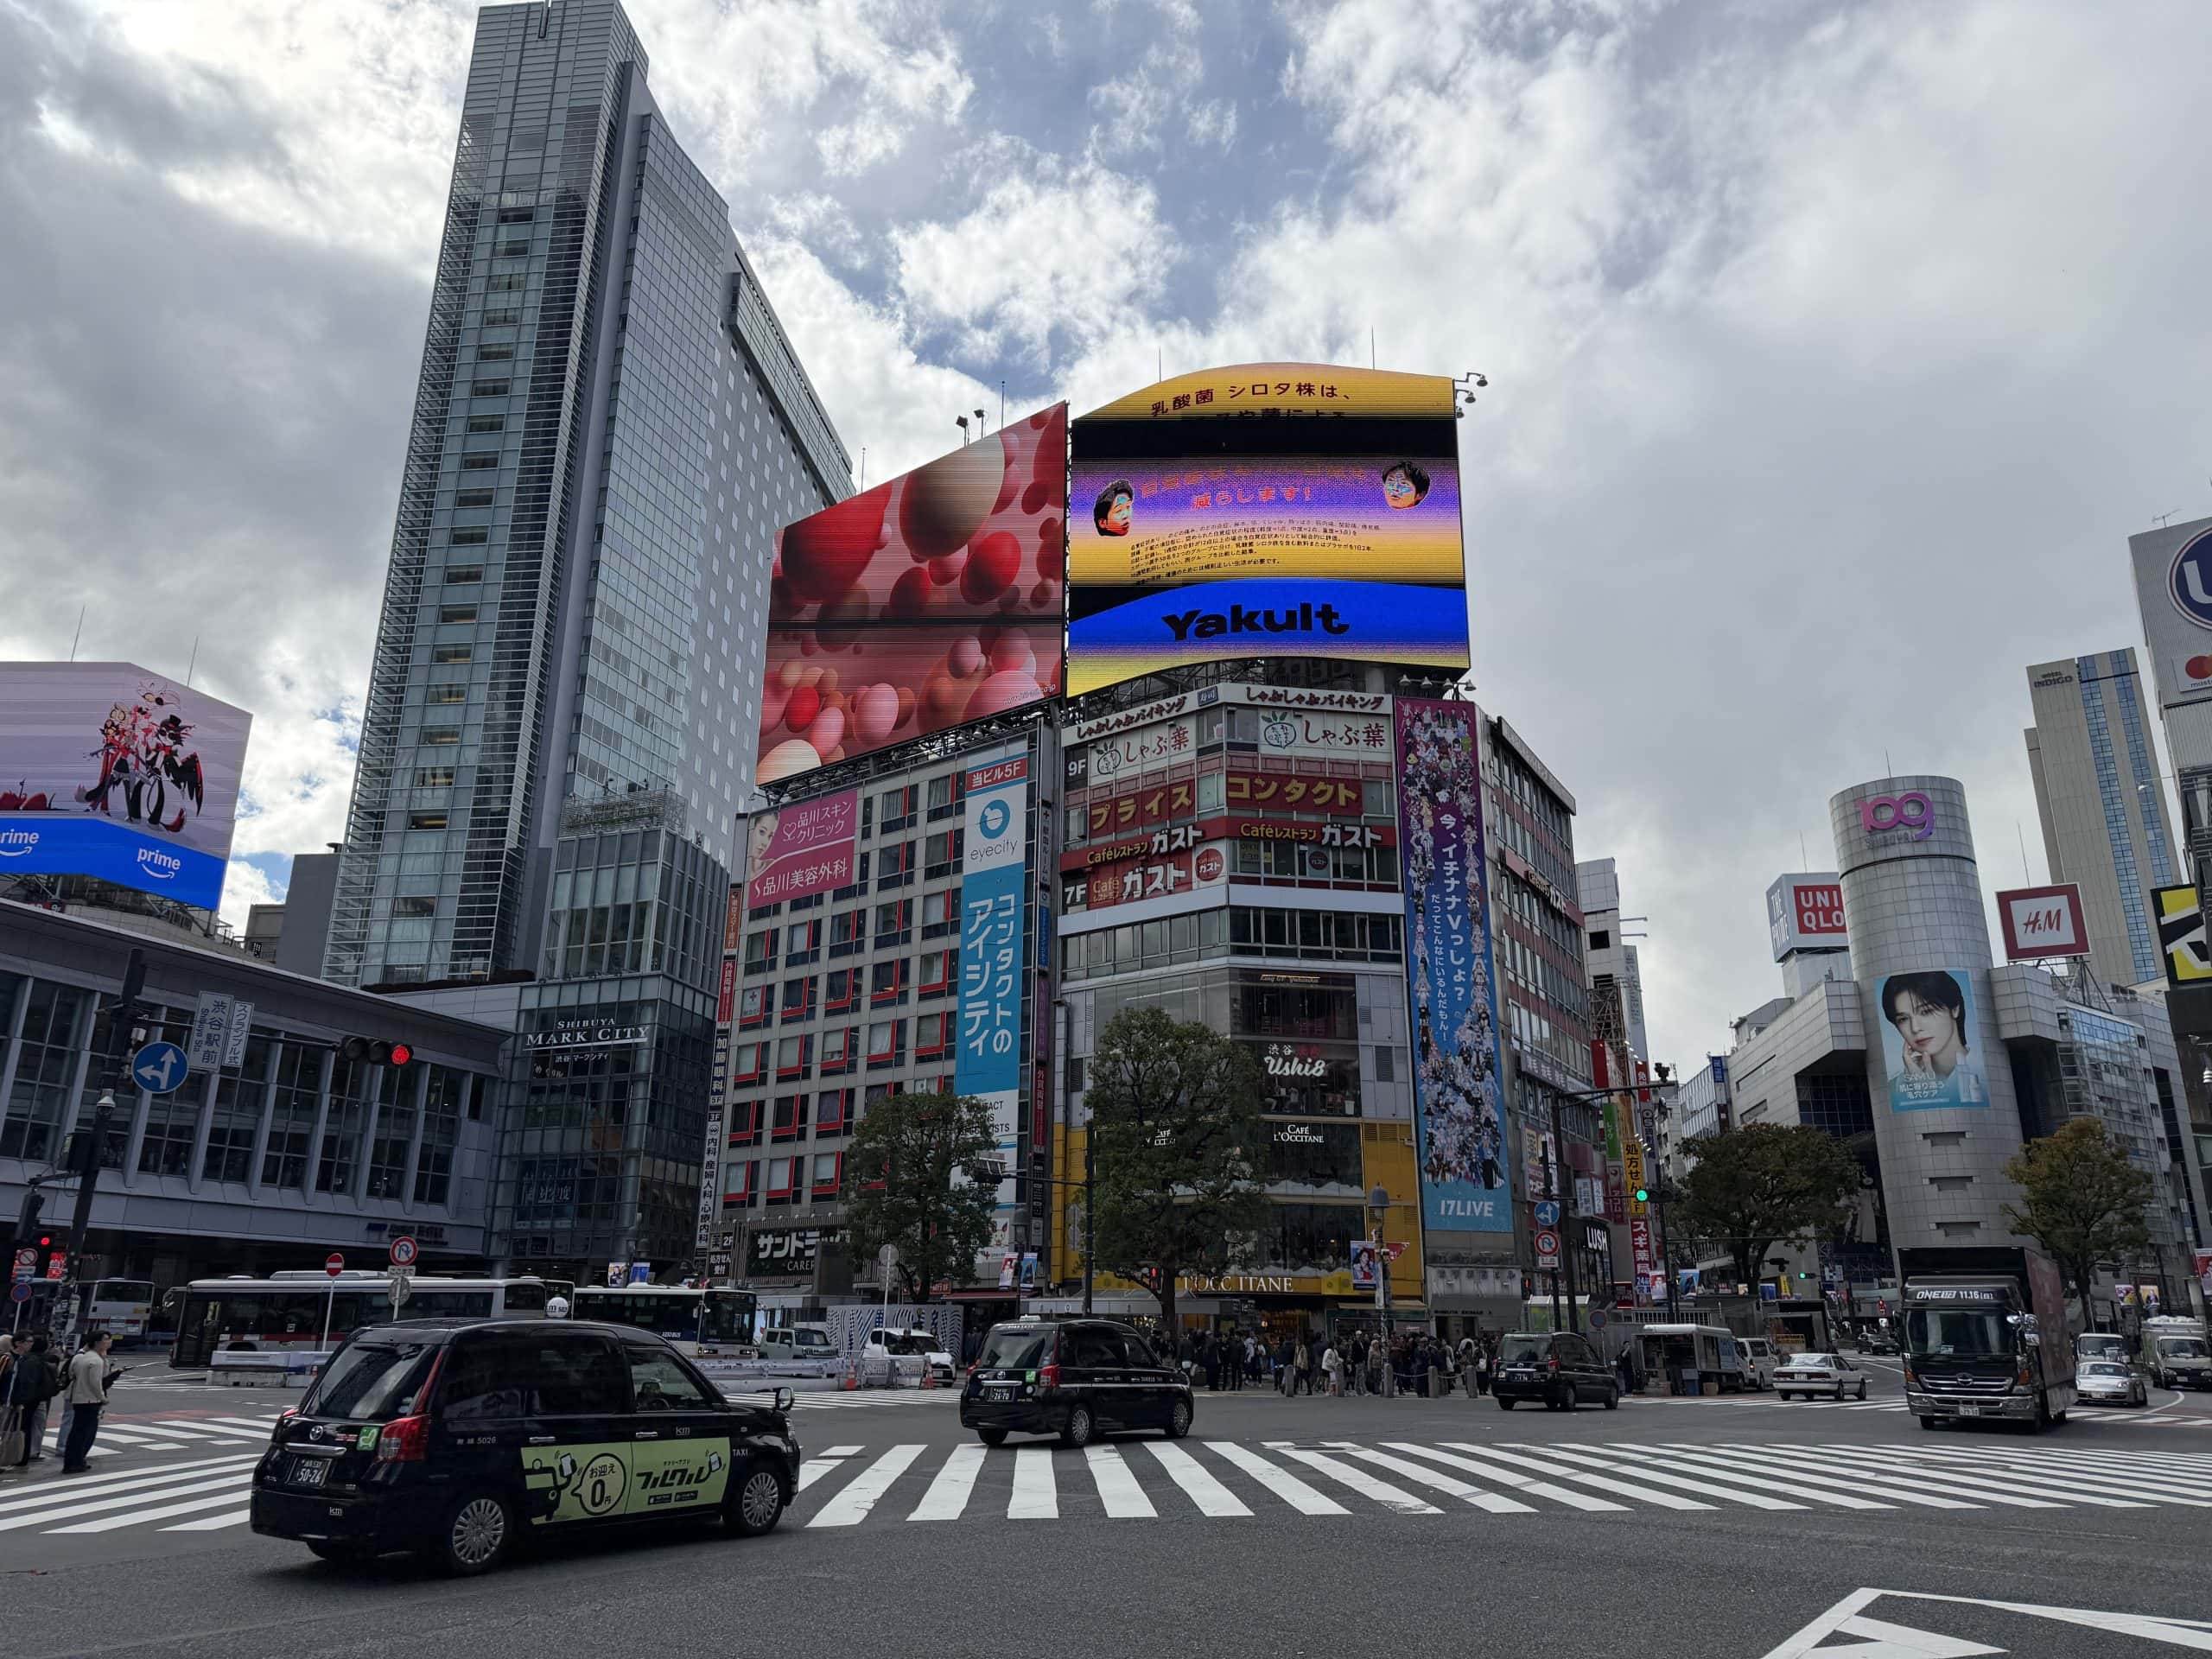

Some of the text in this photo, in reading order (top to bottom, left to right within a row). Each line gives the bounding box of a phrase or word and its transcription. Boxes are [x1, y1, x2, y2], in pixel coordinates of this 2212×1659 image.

[1162, 603, 1351, 641] Yakult
[2034, 676, 2073, 689] INDIGO
[1246, 686, 1384, 710] しゃぶしゃぶバイキング
[1077, 696, 1187, 739] しゃぶしゃぶバイキング
[1126, 725, 1189, 763] しゃぶ葉
[1305, 720, 1385, 747] しゃぶ葉
[971, 761, 1021, 788] 当ビル5F
[1068, 759, 1086, 776] 9F
[1228, 777, 1357, 807] コンタクト
[798, 801, 852, 828] 品川スキン
[1091, 785, 1192, 831] プライス
[0, 829, 40, 845] rime
[796, 820, 845, 844] クリニック
[1151, 824, 1204, 856] ガスト
[1321, 823, 1382, 849] ガスト
[137, 846, 181, 871] prime
[969, 838, 1018, 863] eyecity
[763, 856, 848, 896] 品川美容外科
[1199, 862, 1221, 874] ガスト
[1064, 883, 1087, 904] 7F
[1092, 877, 1120, 893] Café
[1123, 862, 1186, 901] ガスト
[1800, 890, 1840, 908] UNI
[1802, 910, 1845, 931] QLO
[2023, 908, 2062, 934] H&M
[964, 897, 994, 1057] アイシティ
[993, 893, 1016, 1054] コンタクトの
[201, 1000, 227, 1065] 渋谷駅前
[556, 1018, 616, 1030] SHIBUYA
[526, 1027, 650, 1046] MARK CITY
[1268, 1043, 1293, 1056] 渋谷
[1274, 1131, 1325, 1143] L'OCCITANE
[1440, 1199, 1494, 1217] 17LIVE
[1586, 1225, 1608, 1252] LUSH
[1184, 1276, 1294, 1293] L'OCCITANE
[477, 1436, 498, 1445] 5026
[676, 1427, 691, 1437] km
[732, 1447, 748, 1458] TAXI
[589, 1462, 616, 1478] お迎え
[592, 1478, 605, 1508] 0
